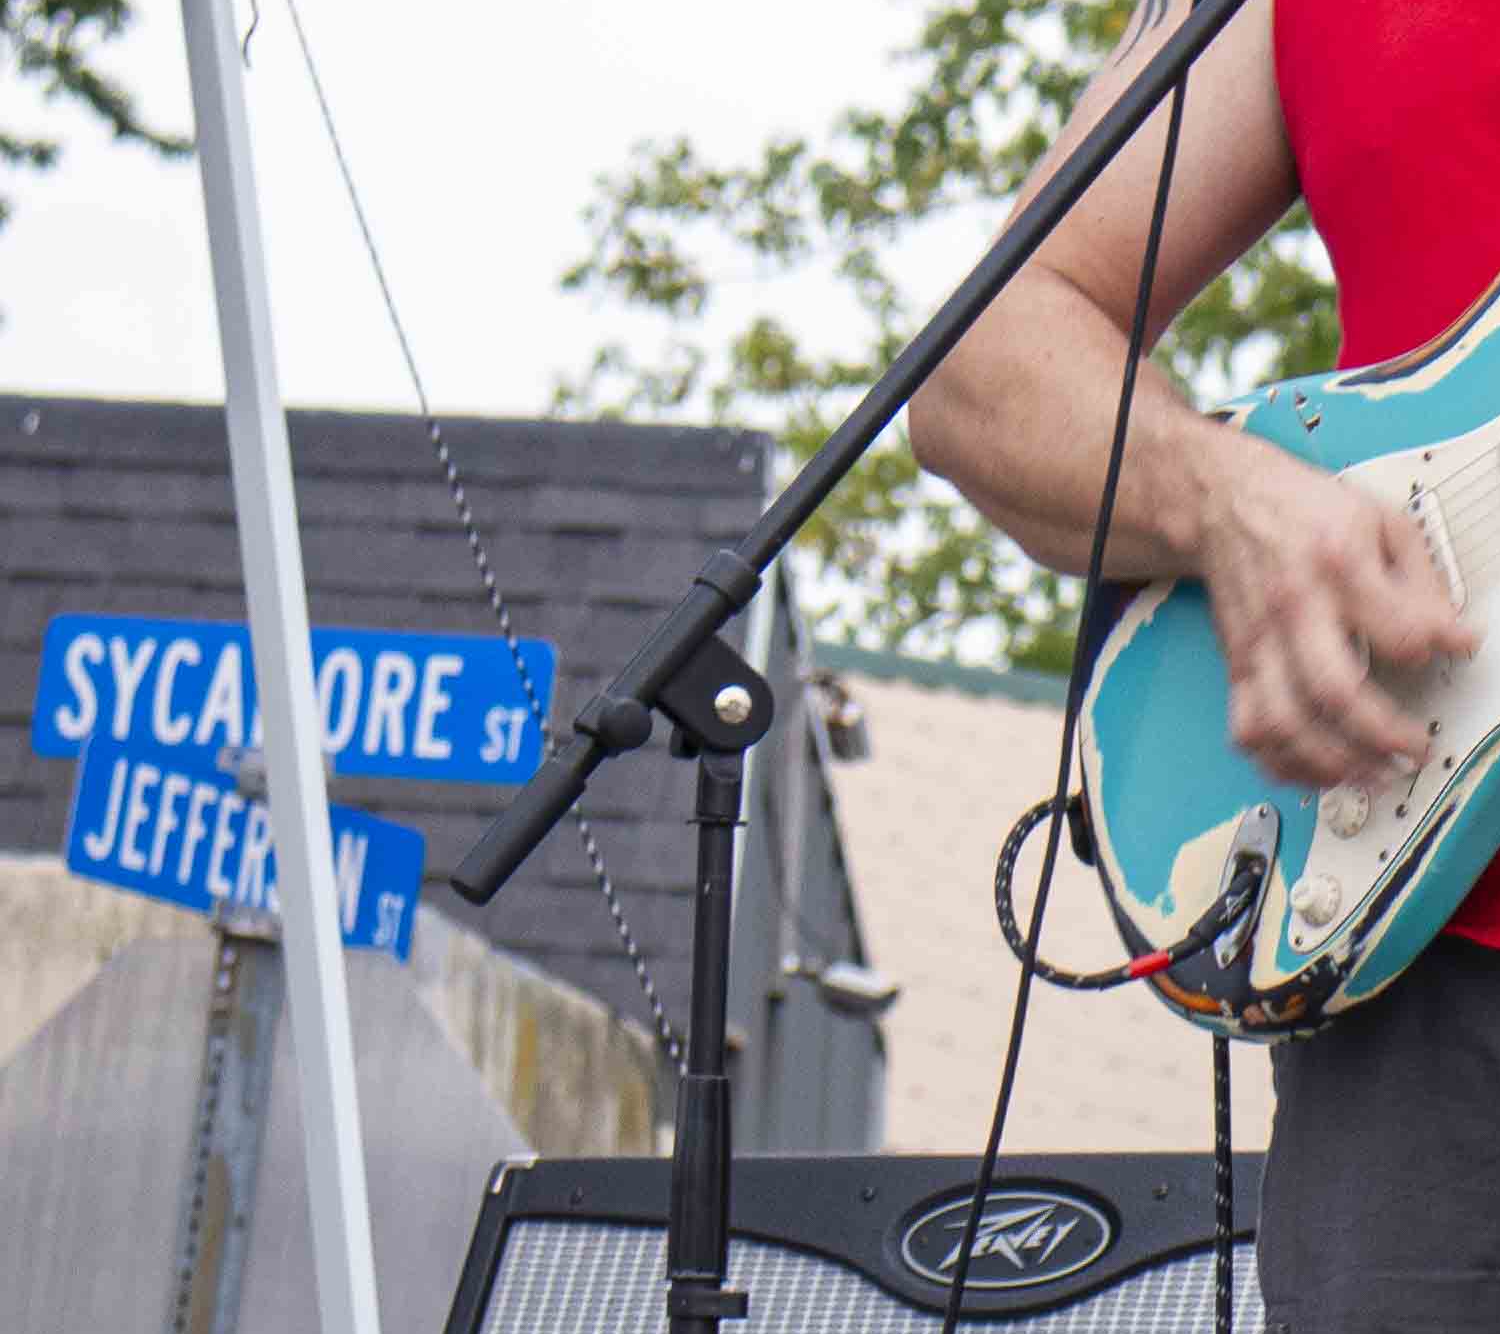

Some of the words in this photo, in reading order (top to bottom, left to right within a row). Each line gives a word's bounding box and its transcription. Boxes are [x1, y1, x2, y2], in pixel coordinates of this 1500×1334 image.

[55, 633, 464, 759] SYCAORE
[480, 706, 527, 763] ST
[83, 758, 369, 934] JEFFERN
[370, 891, 405, 943] ST
